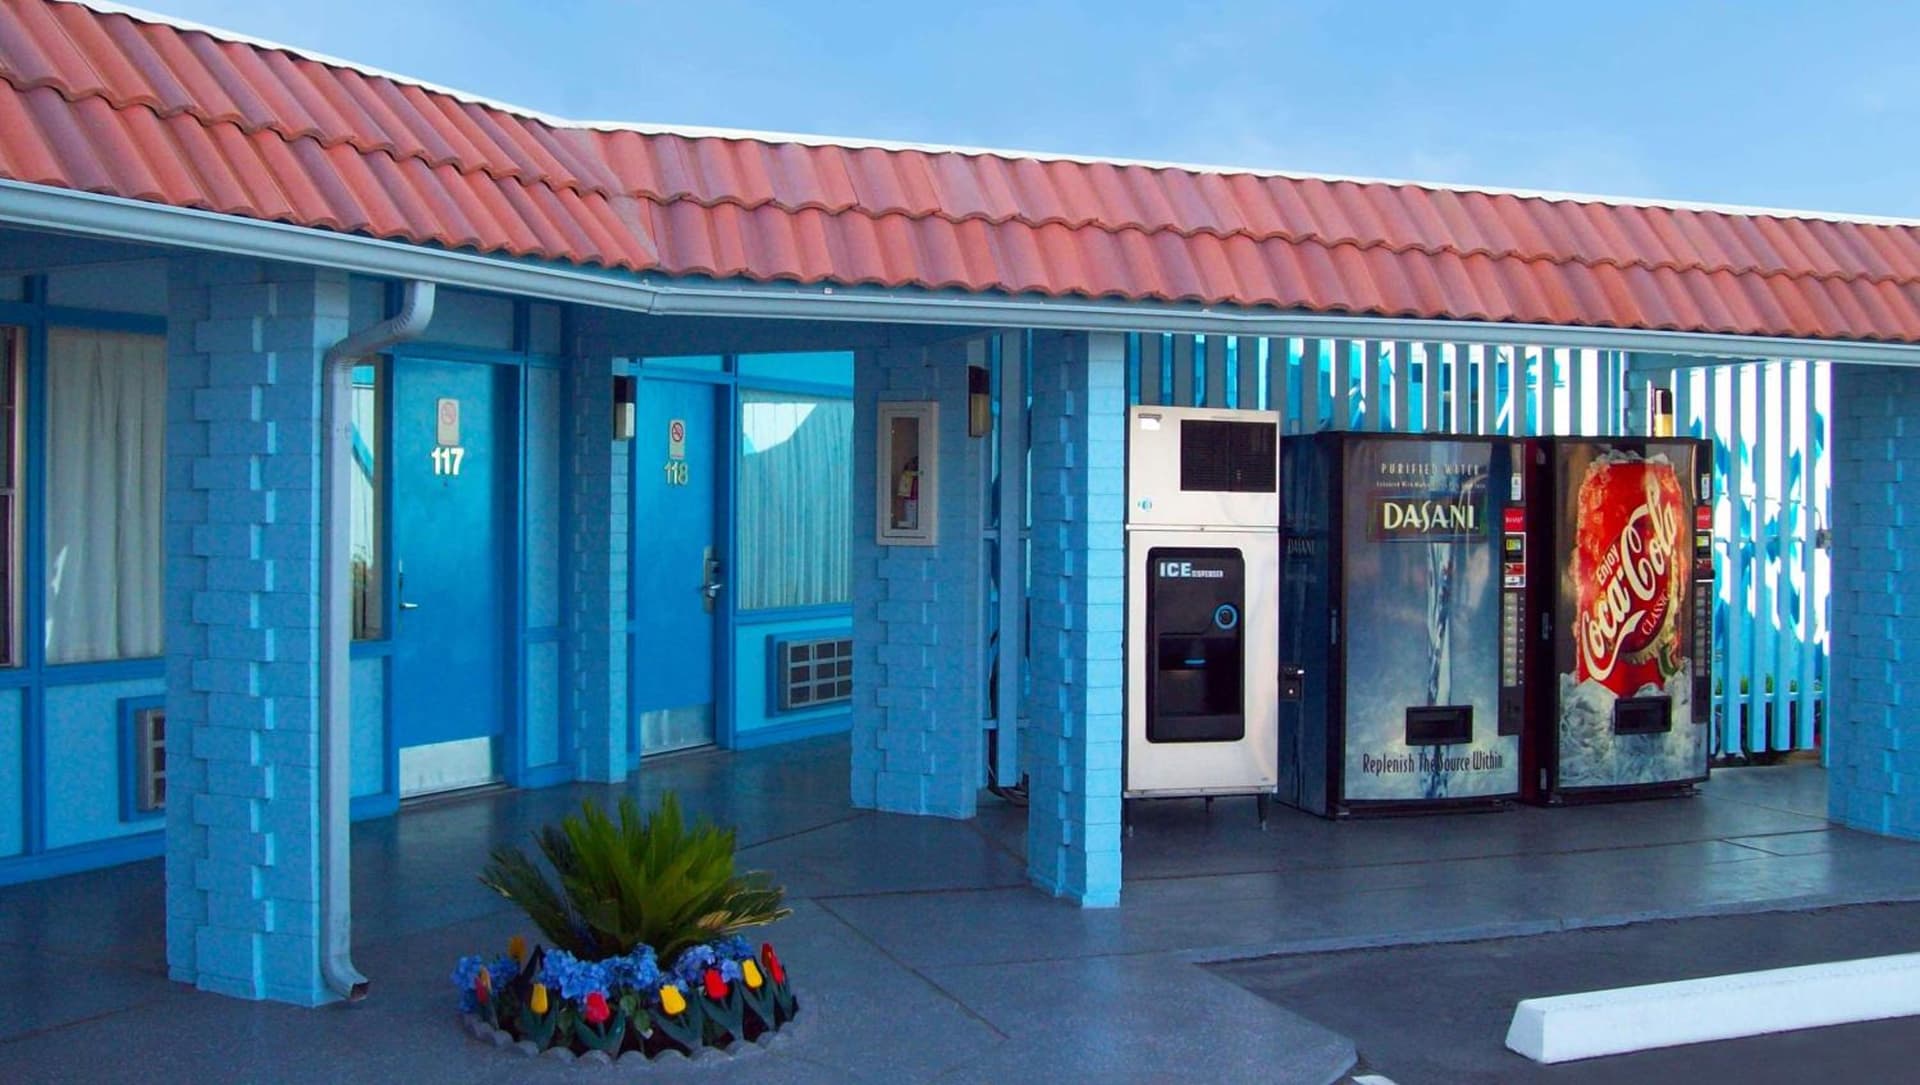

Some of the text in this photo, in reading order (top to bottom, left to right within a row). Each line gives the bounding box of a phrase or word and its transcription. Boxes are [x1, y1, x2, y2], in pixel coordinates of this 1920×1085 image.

[431, 447, 465, 475] 117
[664, 461, 689, 485] 118
[1381, 463, 1438, 474] PURIFIED
[1383, 500, 1475, 533] DASANI
[1160, 562, 1191, 577] ICE
[1582, 473, 1678, 681] Coca-Cola
[1596, 544, 1620, 586] Enjoy
[1363, 750, 1503, 776] Replenish The Source Within
